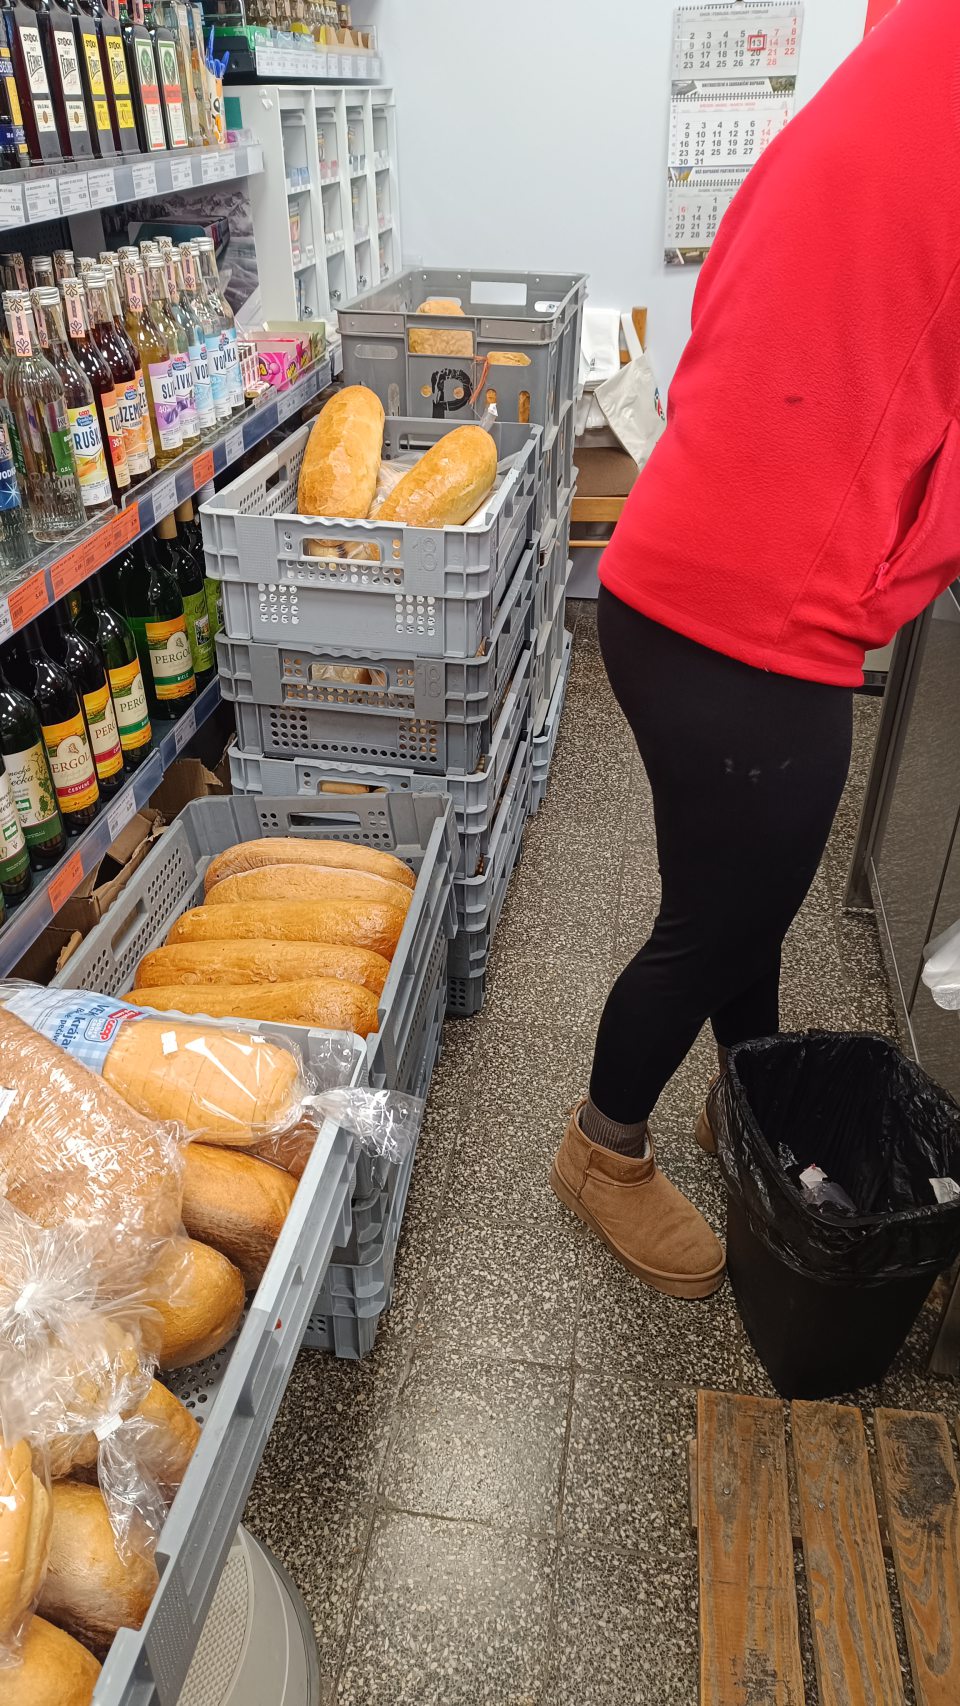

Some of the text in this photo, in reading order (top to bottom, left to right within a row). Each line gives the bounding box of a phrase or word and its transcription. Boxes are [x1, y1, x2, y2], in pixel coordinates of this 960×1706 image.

[23, 33, 38, 43] STOCK
[57, 37, 72, 46] STOCK
[109, 42, 122, 50] STOCK
[61, 1017, 86, 1049] krája
